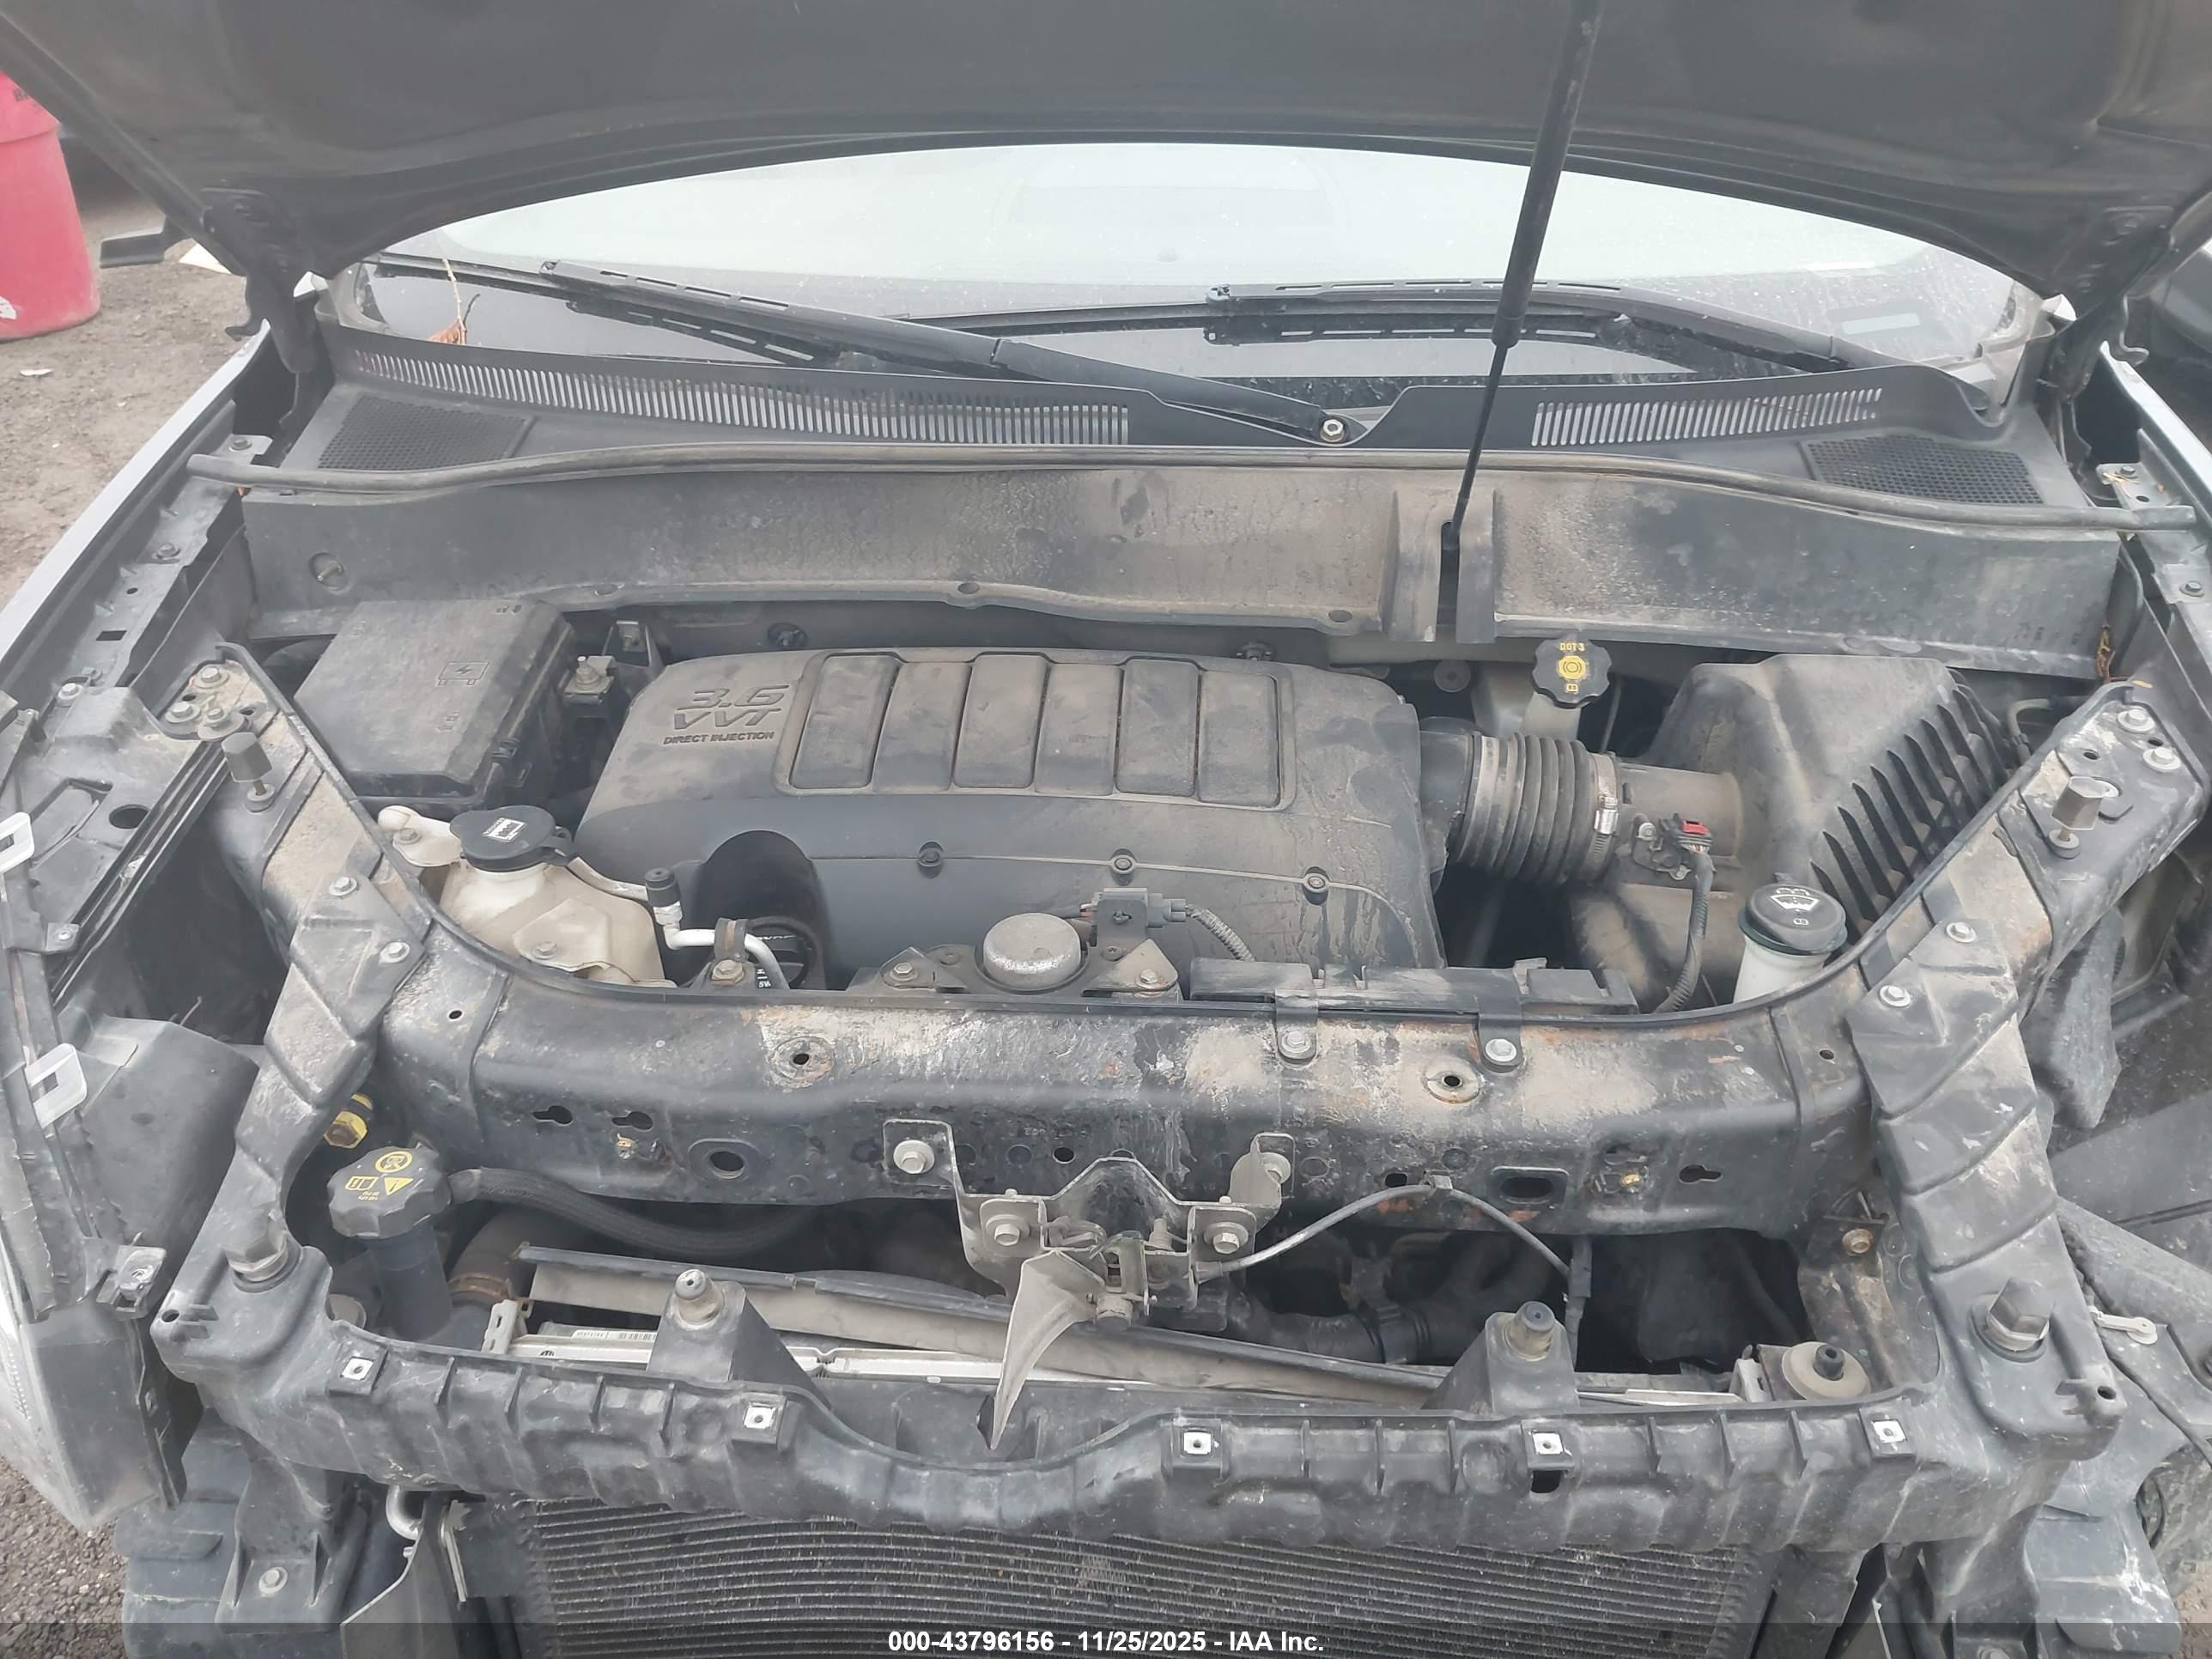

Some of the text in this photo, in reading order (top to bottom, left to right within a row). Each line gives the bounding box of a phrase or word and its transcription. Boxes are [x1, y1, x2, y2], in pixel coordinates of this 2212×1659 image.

[676, 684, 790, 711] 3.6
[673, 708, 782, 730] VVT
[663, 731, 775, 745] DIRECT INJECTION
